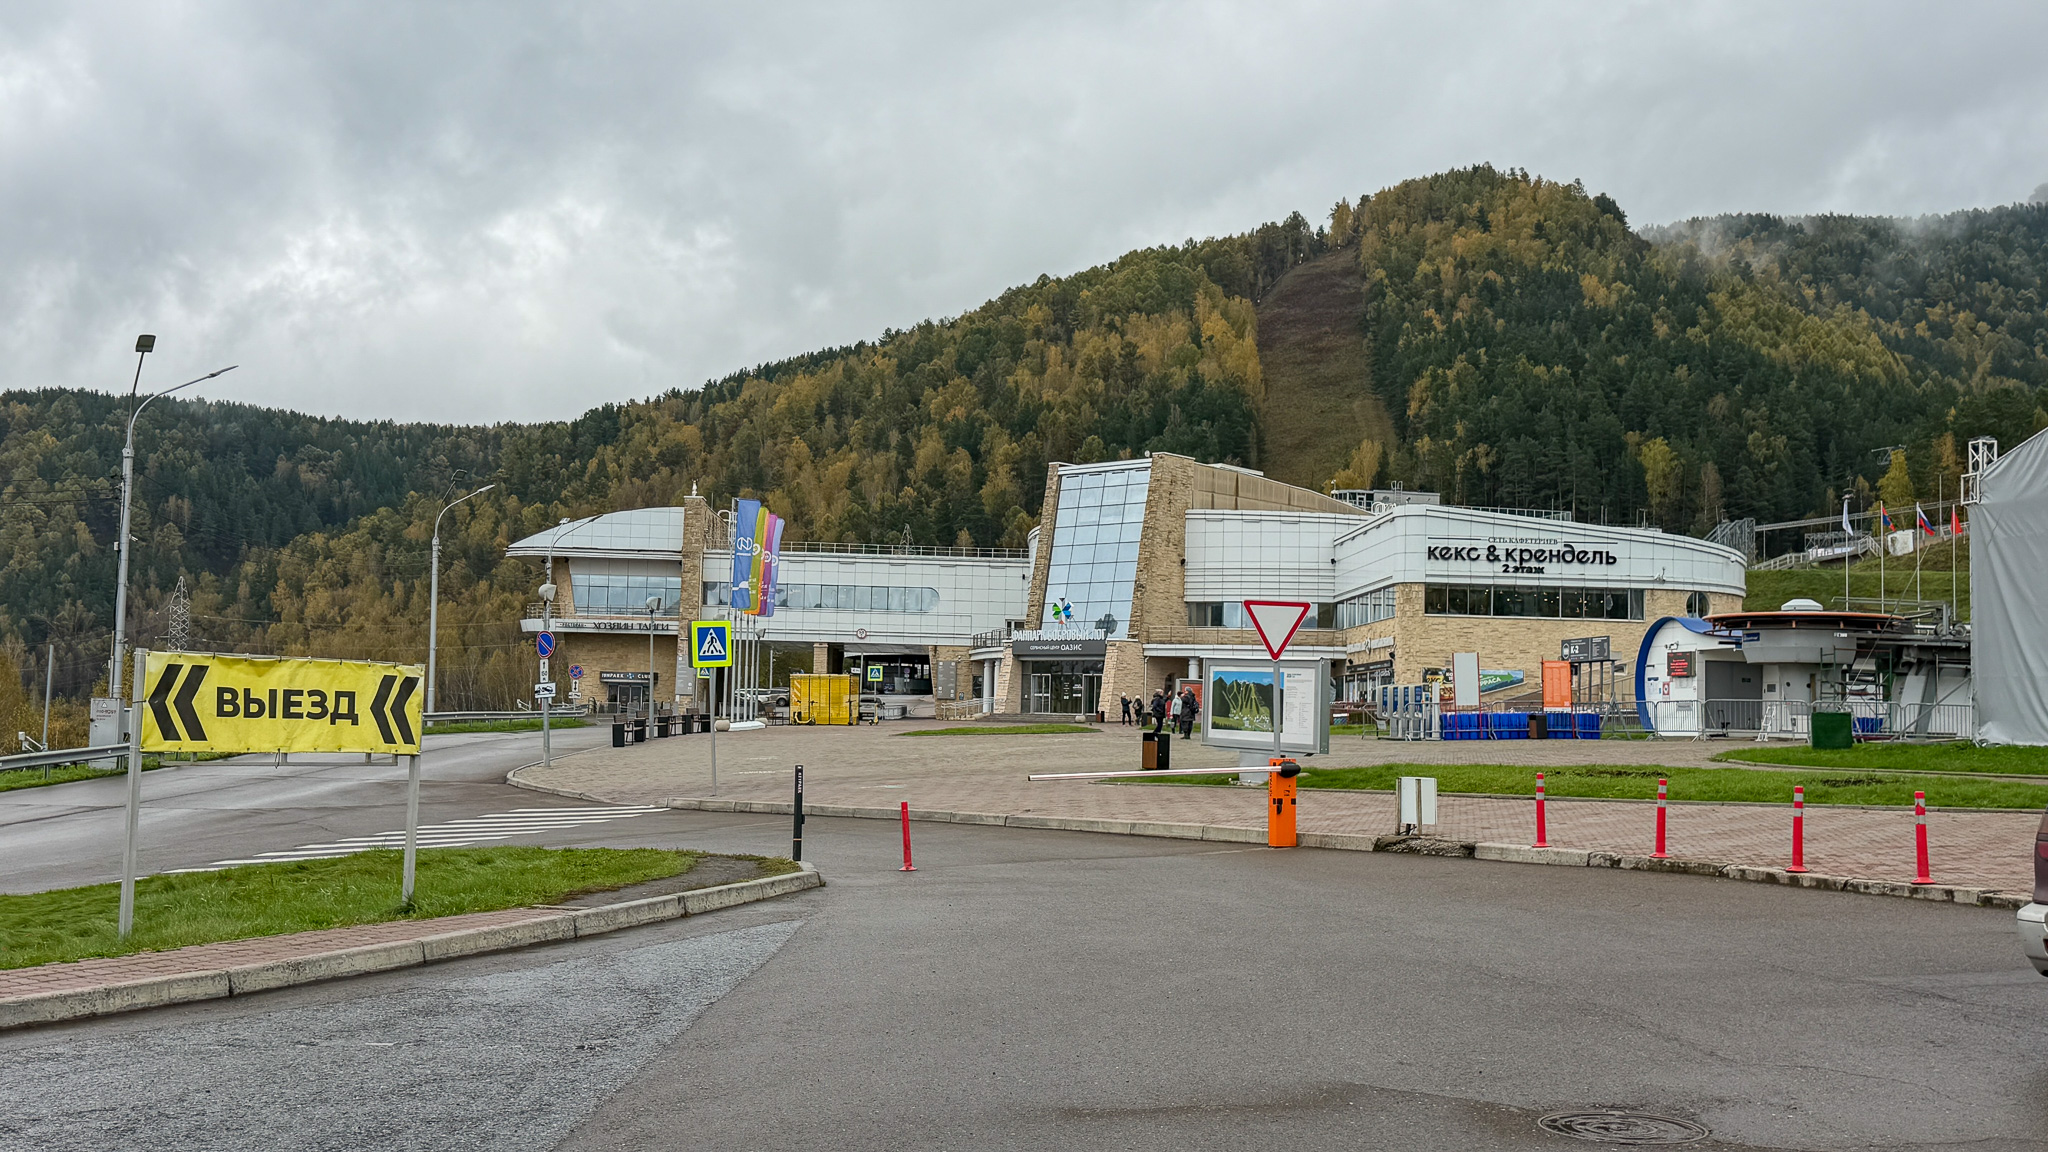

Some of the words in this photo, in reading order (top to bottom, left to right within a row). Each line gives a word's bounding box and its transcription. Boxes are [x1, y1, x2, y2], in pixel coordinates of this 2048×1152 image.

[1487, 536, 1507, 544] СЕТЬ
[1509, 537, 1558, 545] КАФЕТЕРИЕВ
[1427, 545, 1481, 561] кекс
[1486, 544, 1500, 562] &
[1505, 543, 1618, 566] крендель
[1502, 564, 1511, 573] 2
[1512, 565, 1545, 574] этаж
[593, 621, 634, 630] ХОЗЯИН
[1012, 629, 1046, 641] ФАНПАРК
[1048, 628, 1089, 641] БОБРОВЫЙ
[1060, 643, 1083, 651] ОАЗИС
[216, 686, 359, 726] ВЫЕЗД
